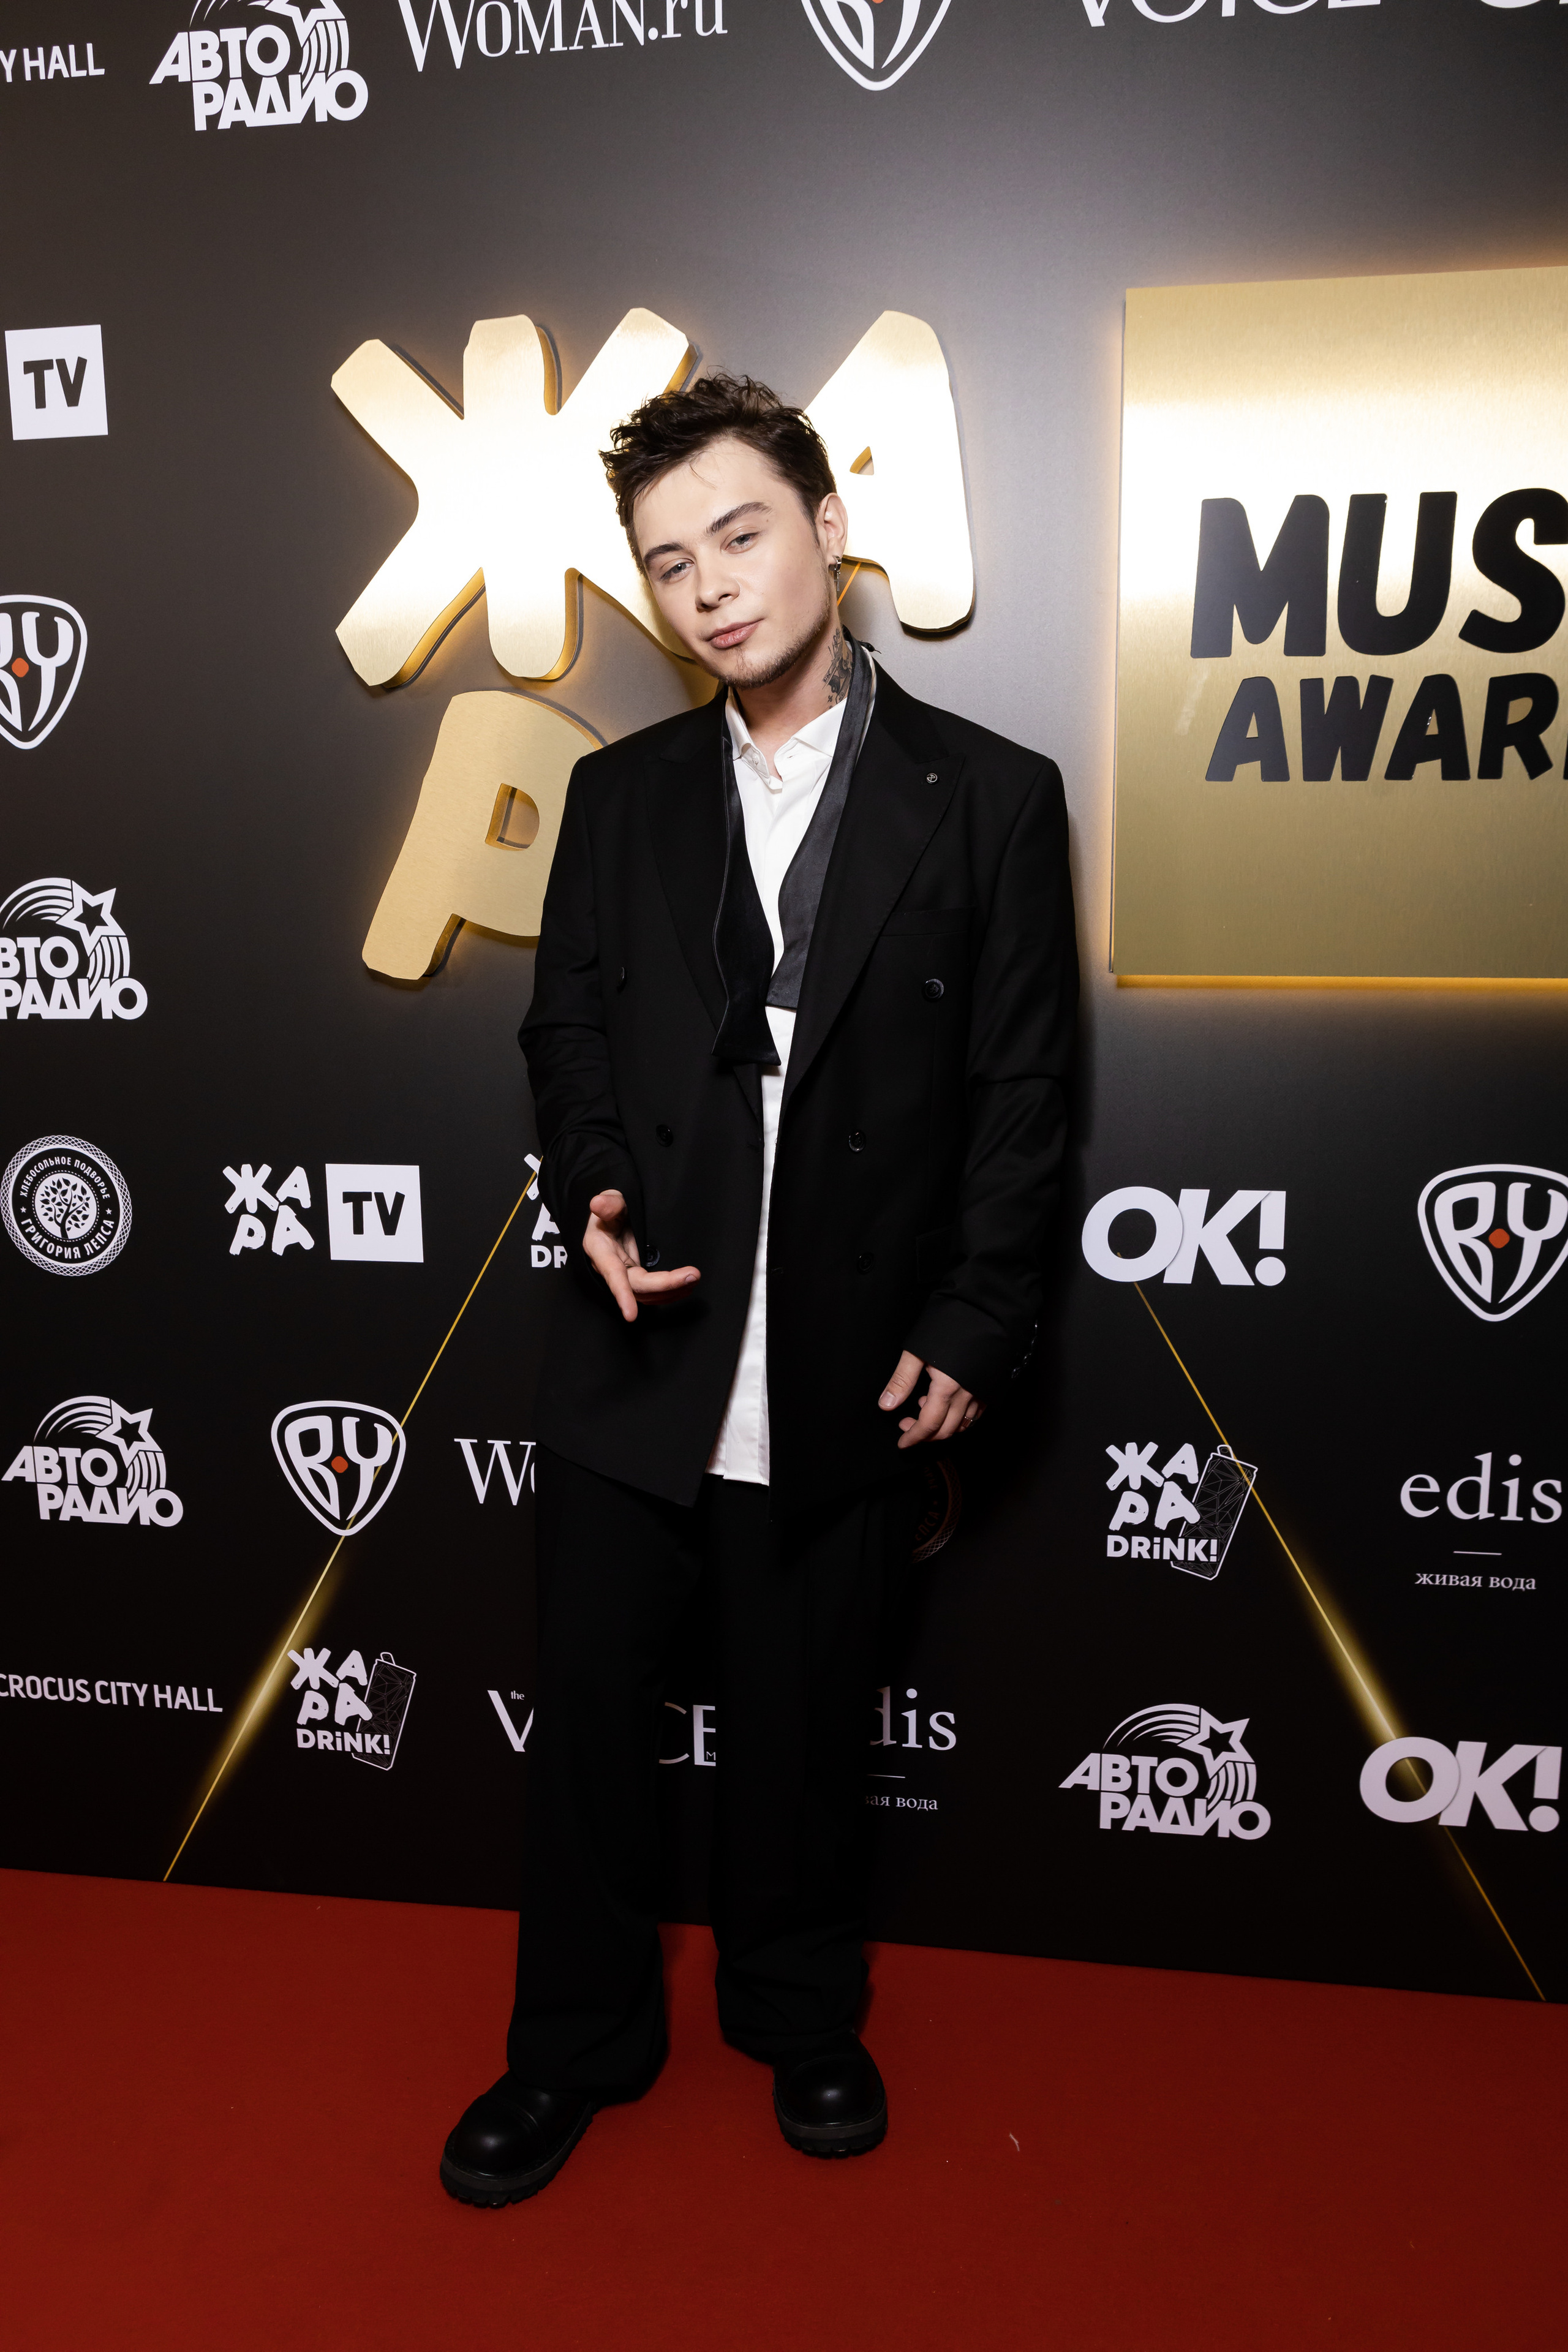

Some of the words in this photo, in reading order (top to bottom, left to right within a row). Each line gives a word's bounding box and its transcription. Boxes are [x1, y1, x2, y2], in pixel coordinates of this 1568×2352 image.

[23, 43, 105, 80] HALL
[149, 25, 292, 85] АВТО
[192, 70, 368, 130] РАДИО
[23, 356, 87, 409] TV
[1191, 488, 1568, 658] MUS
[1205, 673, 1568, 782] AWAR
[0, 978, 148, 1019] РАДИО
[20, 1156, 71, 1197] ХЛЕБОСОЛЬНОЕ
[74, 1159, 117, 1199] ПОДВОРЬЕ
[223, 1164, 311, 1213] ЖА
[342, 1192, 405, 1235] TV
[18, 1219, 81, 1259] ГРИГОРИЯ
[84, 1220, 114, 1255] ЛЕПСА
[1082, 1186, 1286, 1286] OK!
[1, 1446, 117, 1486] АВТО
[454, 1439, 536, 1506] W
[1106, 1442, 1198, 1490] ЖА
[1401, 1452, 1561, 1523] edis
[37, 1483, 183, 1526] РАДИО
[1415, 1574, 1482, 1586] живая
[1489, 1577, 1536, 1590] вода
[288, 1648, 368, 1689] ЖА
[0, 1674, 91, 1702] CROCUS
[96, 1681, 148, 1706] CITY
[154, 1685, 222, 1712] HALL
[511, 1691, 524, 1700] the
[1059, 1753, 1199, 1796] АВТО
[1360, 1736, 1561, 1833] OK!
[896, 1798, 938, 1811] вода
[1100, 1792, 1270, 1839] РАДИО
